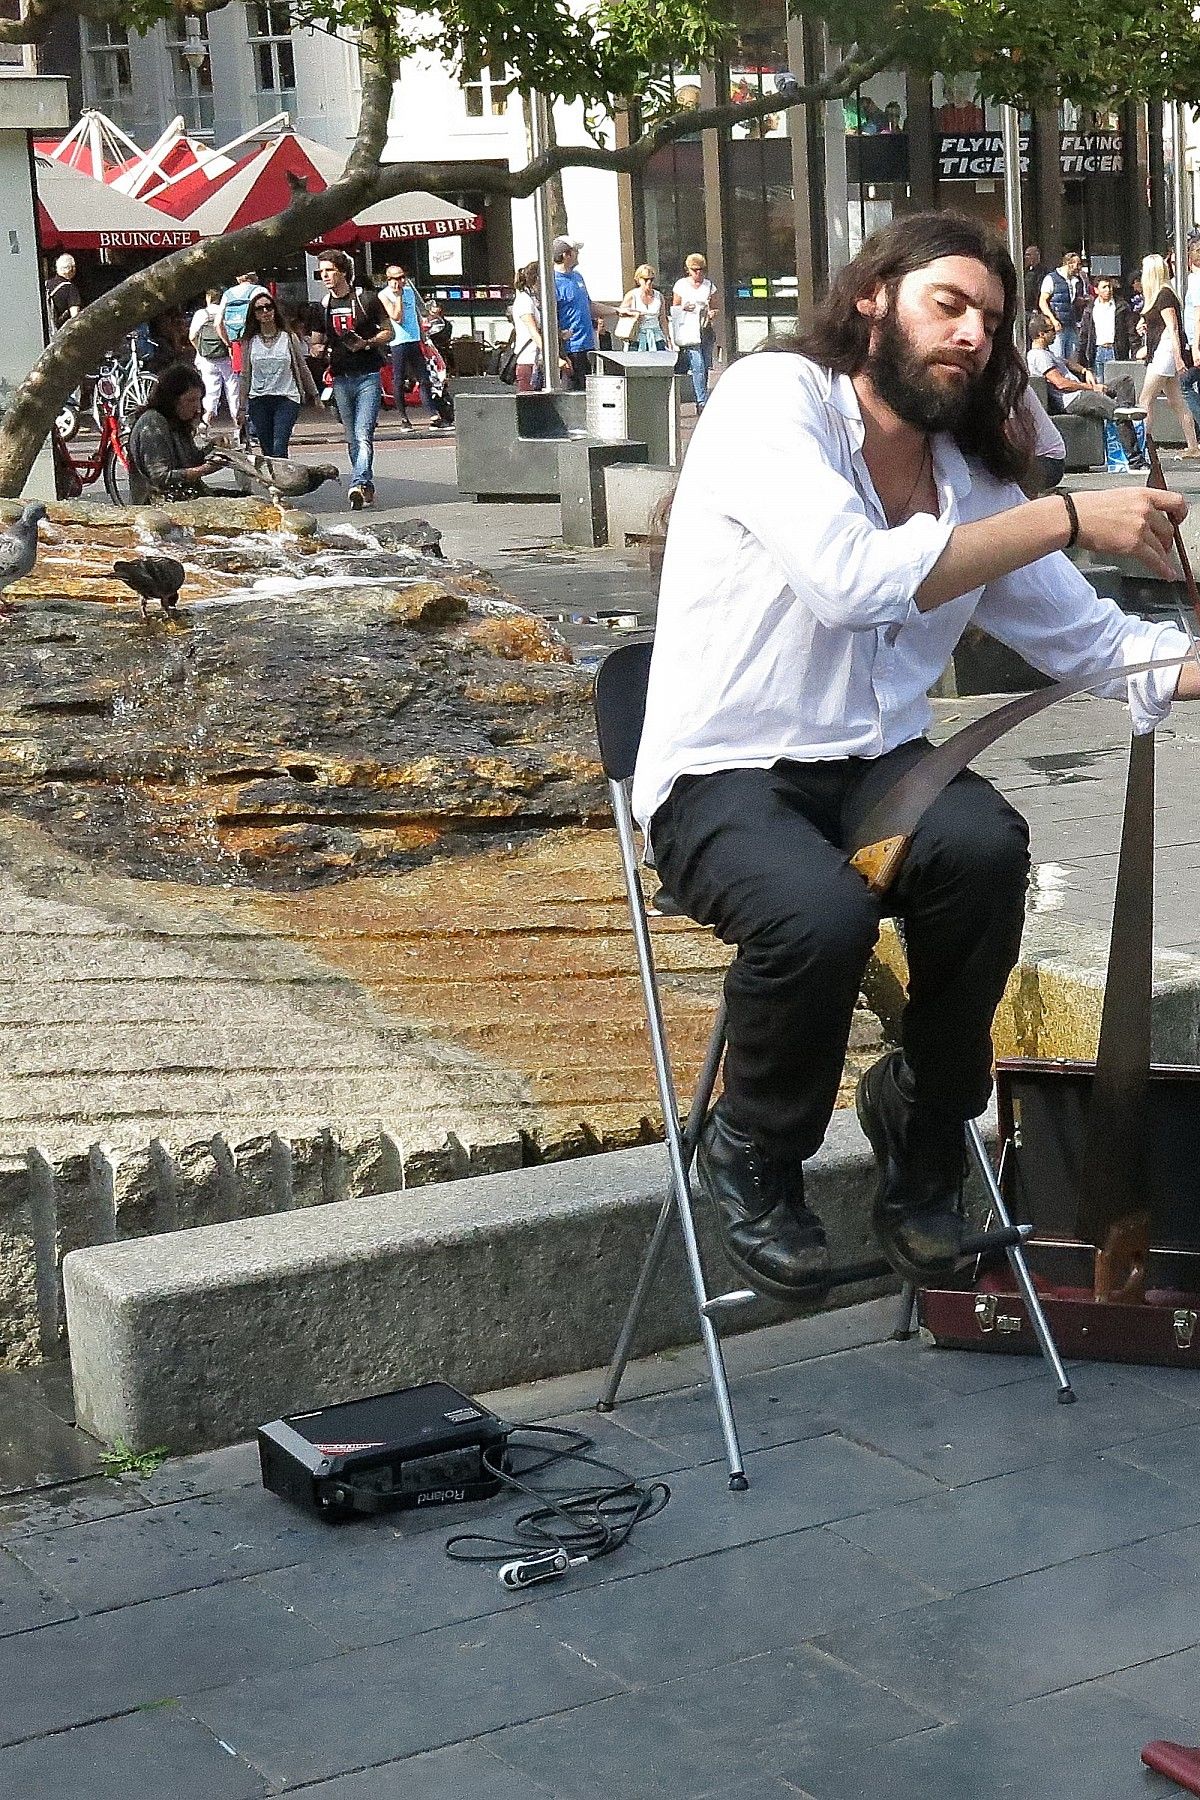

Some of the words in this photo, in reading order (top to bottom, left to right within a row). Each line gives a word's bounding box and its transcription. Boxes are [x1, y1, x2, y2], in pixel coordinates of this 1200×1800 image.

[941, 137, 1030, 153] FLYING
[1061, 136, 1123, 151] FLYING
[939, 156, 1030, 174] TIGER
[1059, 155, 1123, 173] TIGER
[379, 222, 431, 239] AMSTEL
[435, 217, 477, 234] BIER
[100, 232, 192, 247] BRUINCAFE
[417, 1490, 465, 1504] Roland
